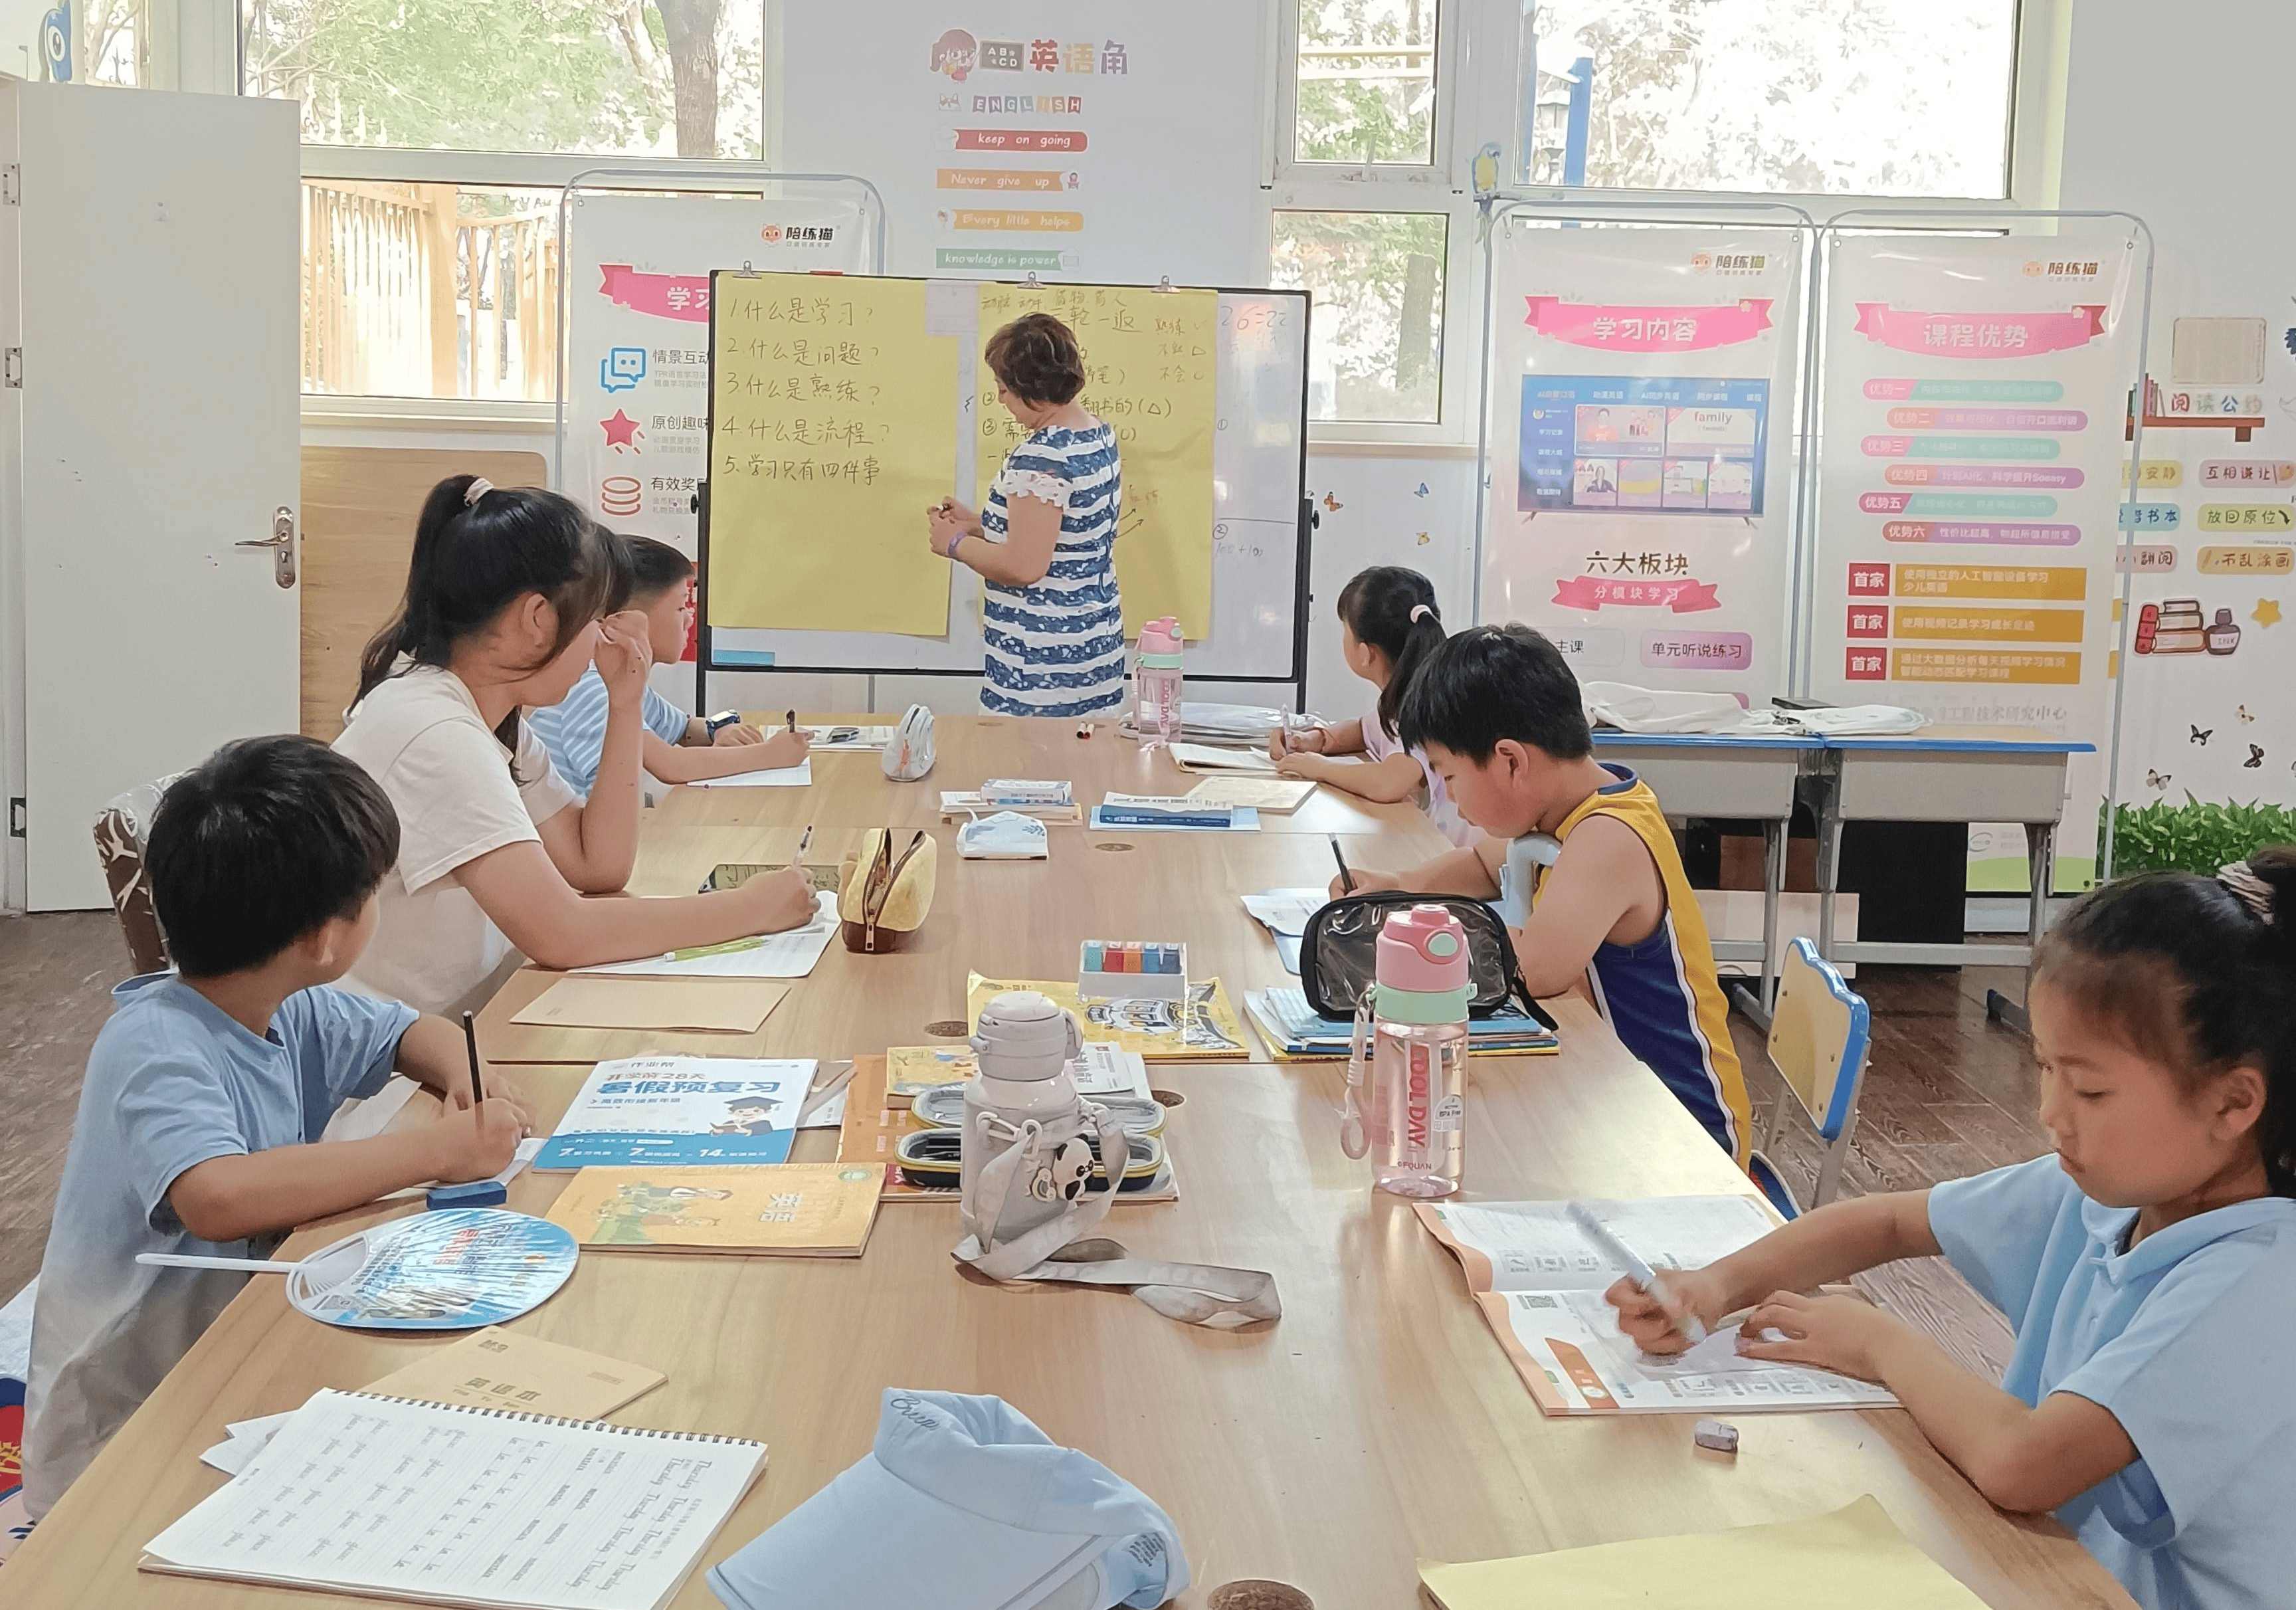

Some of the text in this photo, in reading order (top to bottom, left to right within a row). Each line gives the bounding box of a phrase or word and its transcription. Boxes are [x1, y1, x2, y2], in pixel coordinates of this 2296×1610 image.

[1030, 39, 1127, 74] 英语角
[977, 100, 1080, 111] ENGLISH
[978, 134, 1004, 146] keep
[1040, 135, 1071, 148] going
[951, 173, 1050, 189] Never give up
[963, 213, 1070, 228] Every little helps
[786, 227, 834, 241] 陪练猫
[945, 252, 1056, 267] knowledge is power
[2048, 262, 2098, 275] 陪练猫
[1593, 317, 1697, 342] 学习内容
[1923, 324, 2028, 349] 课程优势
[652, 350, 709, 365] 情景互动
[2171, 393, 2262, 412] 阅读公约
[652, 415, 708, 430] 原创趣味
[1694, 411, 1732, 425] family
[1867, 441, 1903, 453] 优势三
[1891, 468, 1927, 480] 优势四
[1866, 497, 1901, 509] 优势五
[2207, 510, 2276, 525] 放回原位
[1889, 526, 1926, 538] 优势六
[1586, 551, 1688, 575] 六大板块
[2222, 552, 2289, 567] 不乱涂画
[1854, 572, 1885, 587] 首家
[1594, 585, 1679, 601] 分模块学习
[1852, 615, 1883, 631] 首家
[1555, 639, 1584, 654] 主课
[1652, 642, 1743, 659] 单元听说练习
[1851, 656, 1881, 672] 首家
[597, 1081, 781, 1094] 暑假预复习
[466, 1377, 541, 1401] 英语本
